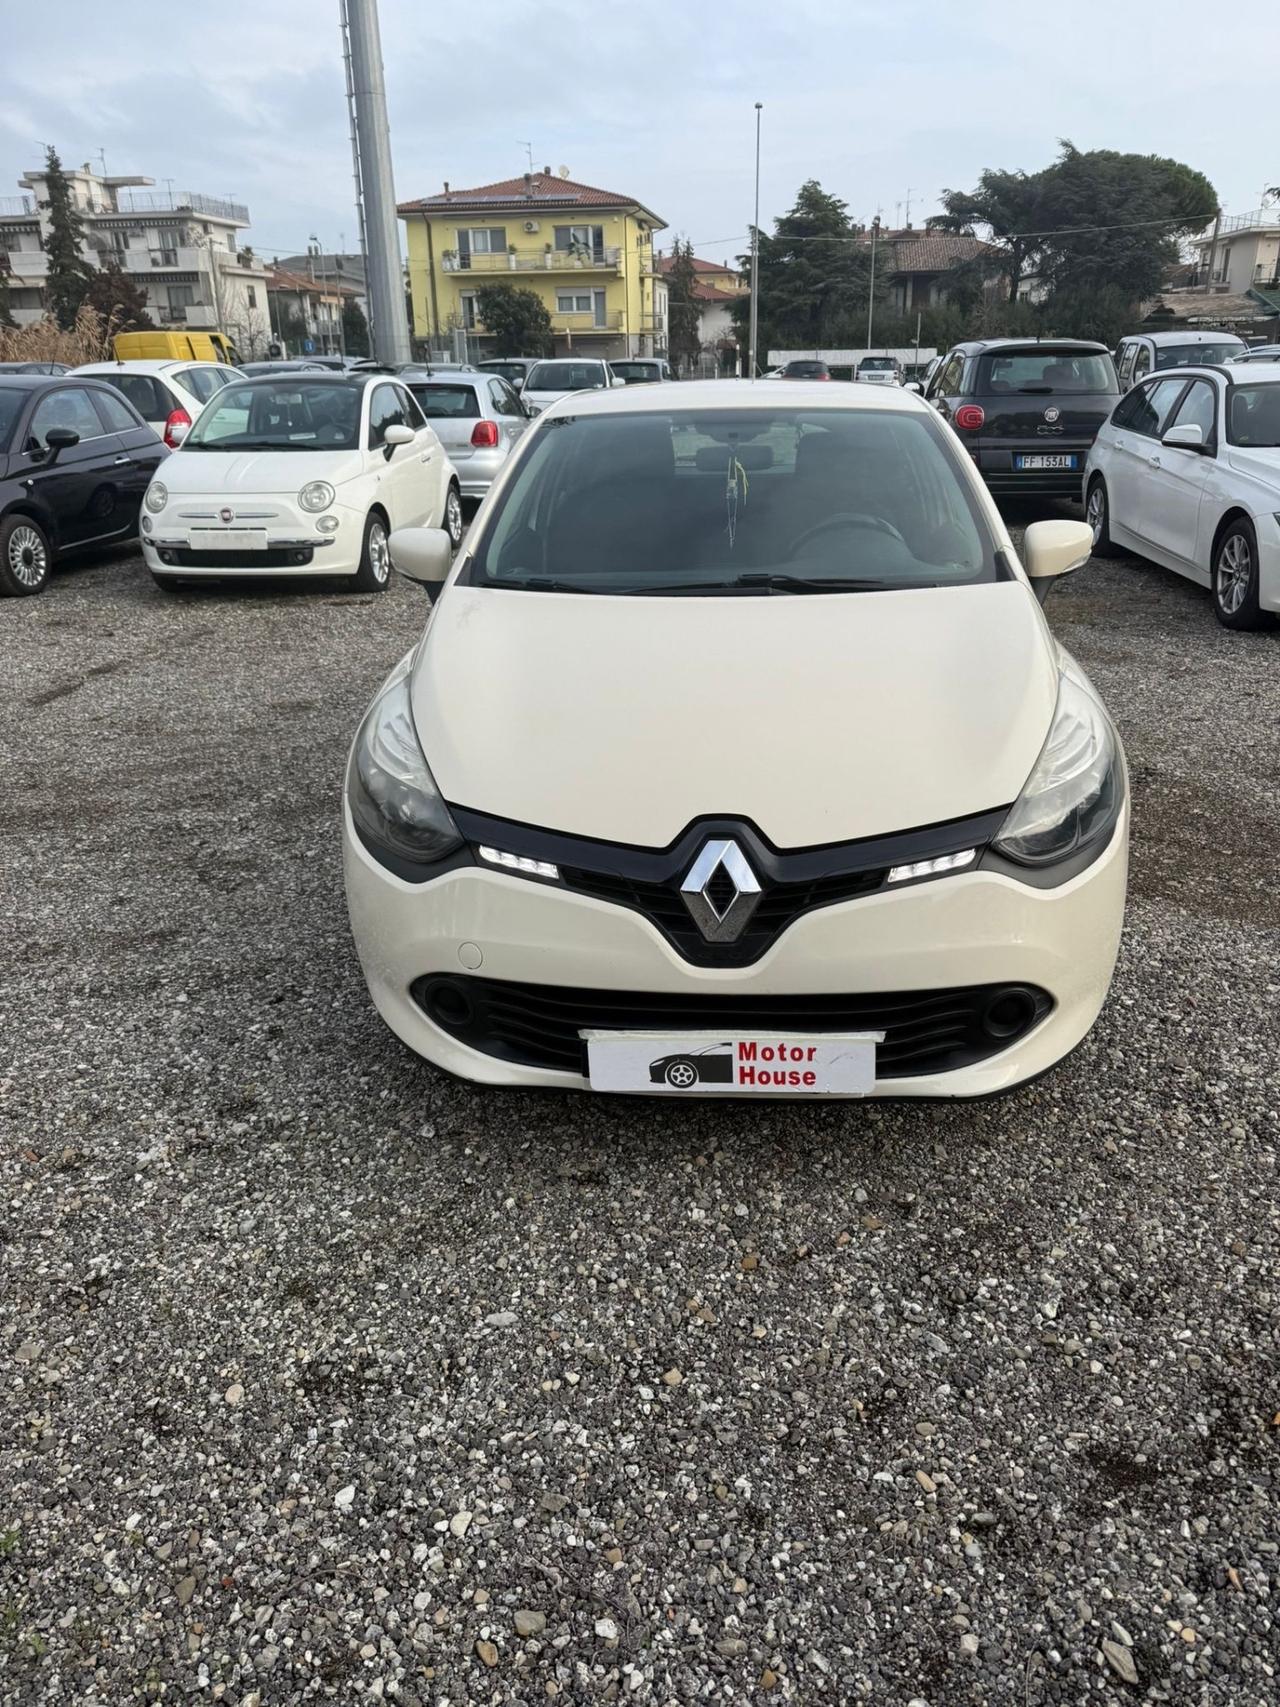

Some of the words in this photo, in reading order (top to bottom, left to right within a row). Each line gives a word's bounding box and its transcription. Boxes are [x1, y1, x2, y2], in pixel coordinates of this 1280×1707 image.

[1023, 456, 1034, 468] FF
[1040, 456, 1070, 468] 153AL
[738, 1042, 817, 1062] Motor
[739, 1065, 817, 1086] House
